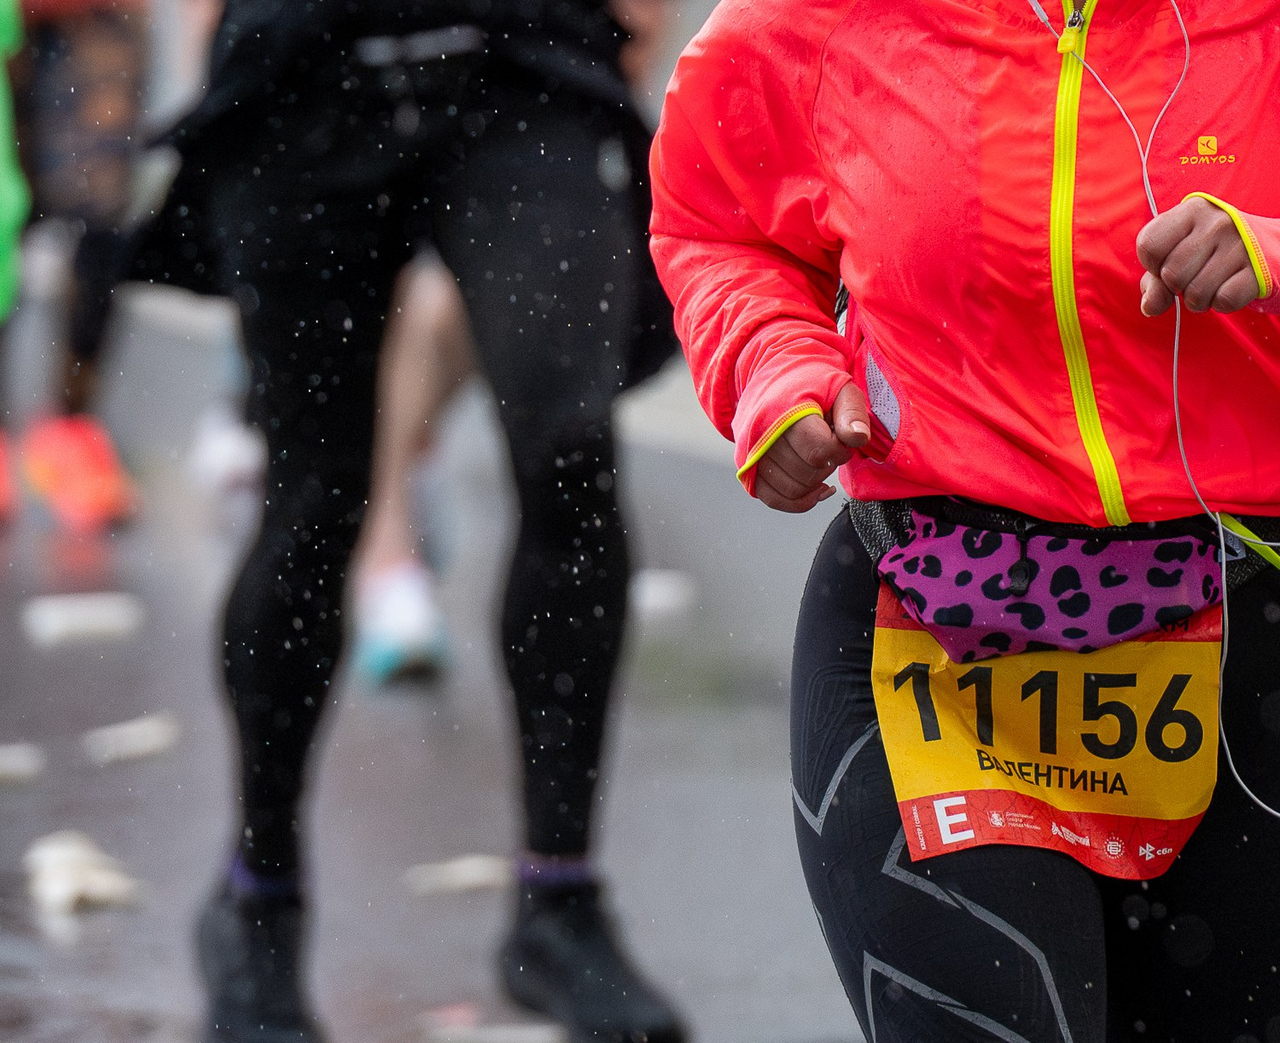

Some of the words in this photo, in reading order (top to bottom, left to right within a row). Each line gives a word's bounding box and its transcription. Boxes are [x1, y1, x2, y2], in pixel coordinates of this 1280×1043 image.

[1179, 154, 1236, 165] DOMYOS
[893, 661, 1204, 763] 11156
[976, 748, 1129, 796] ВАЛЕНТИНА
